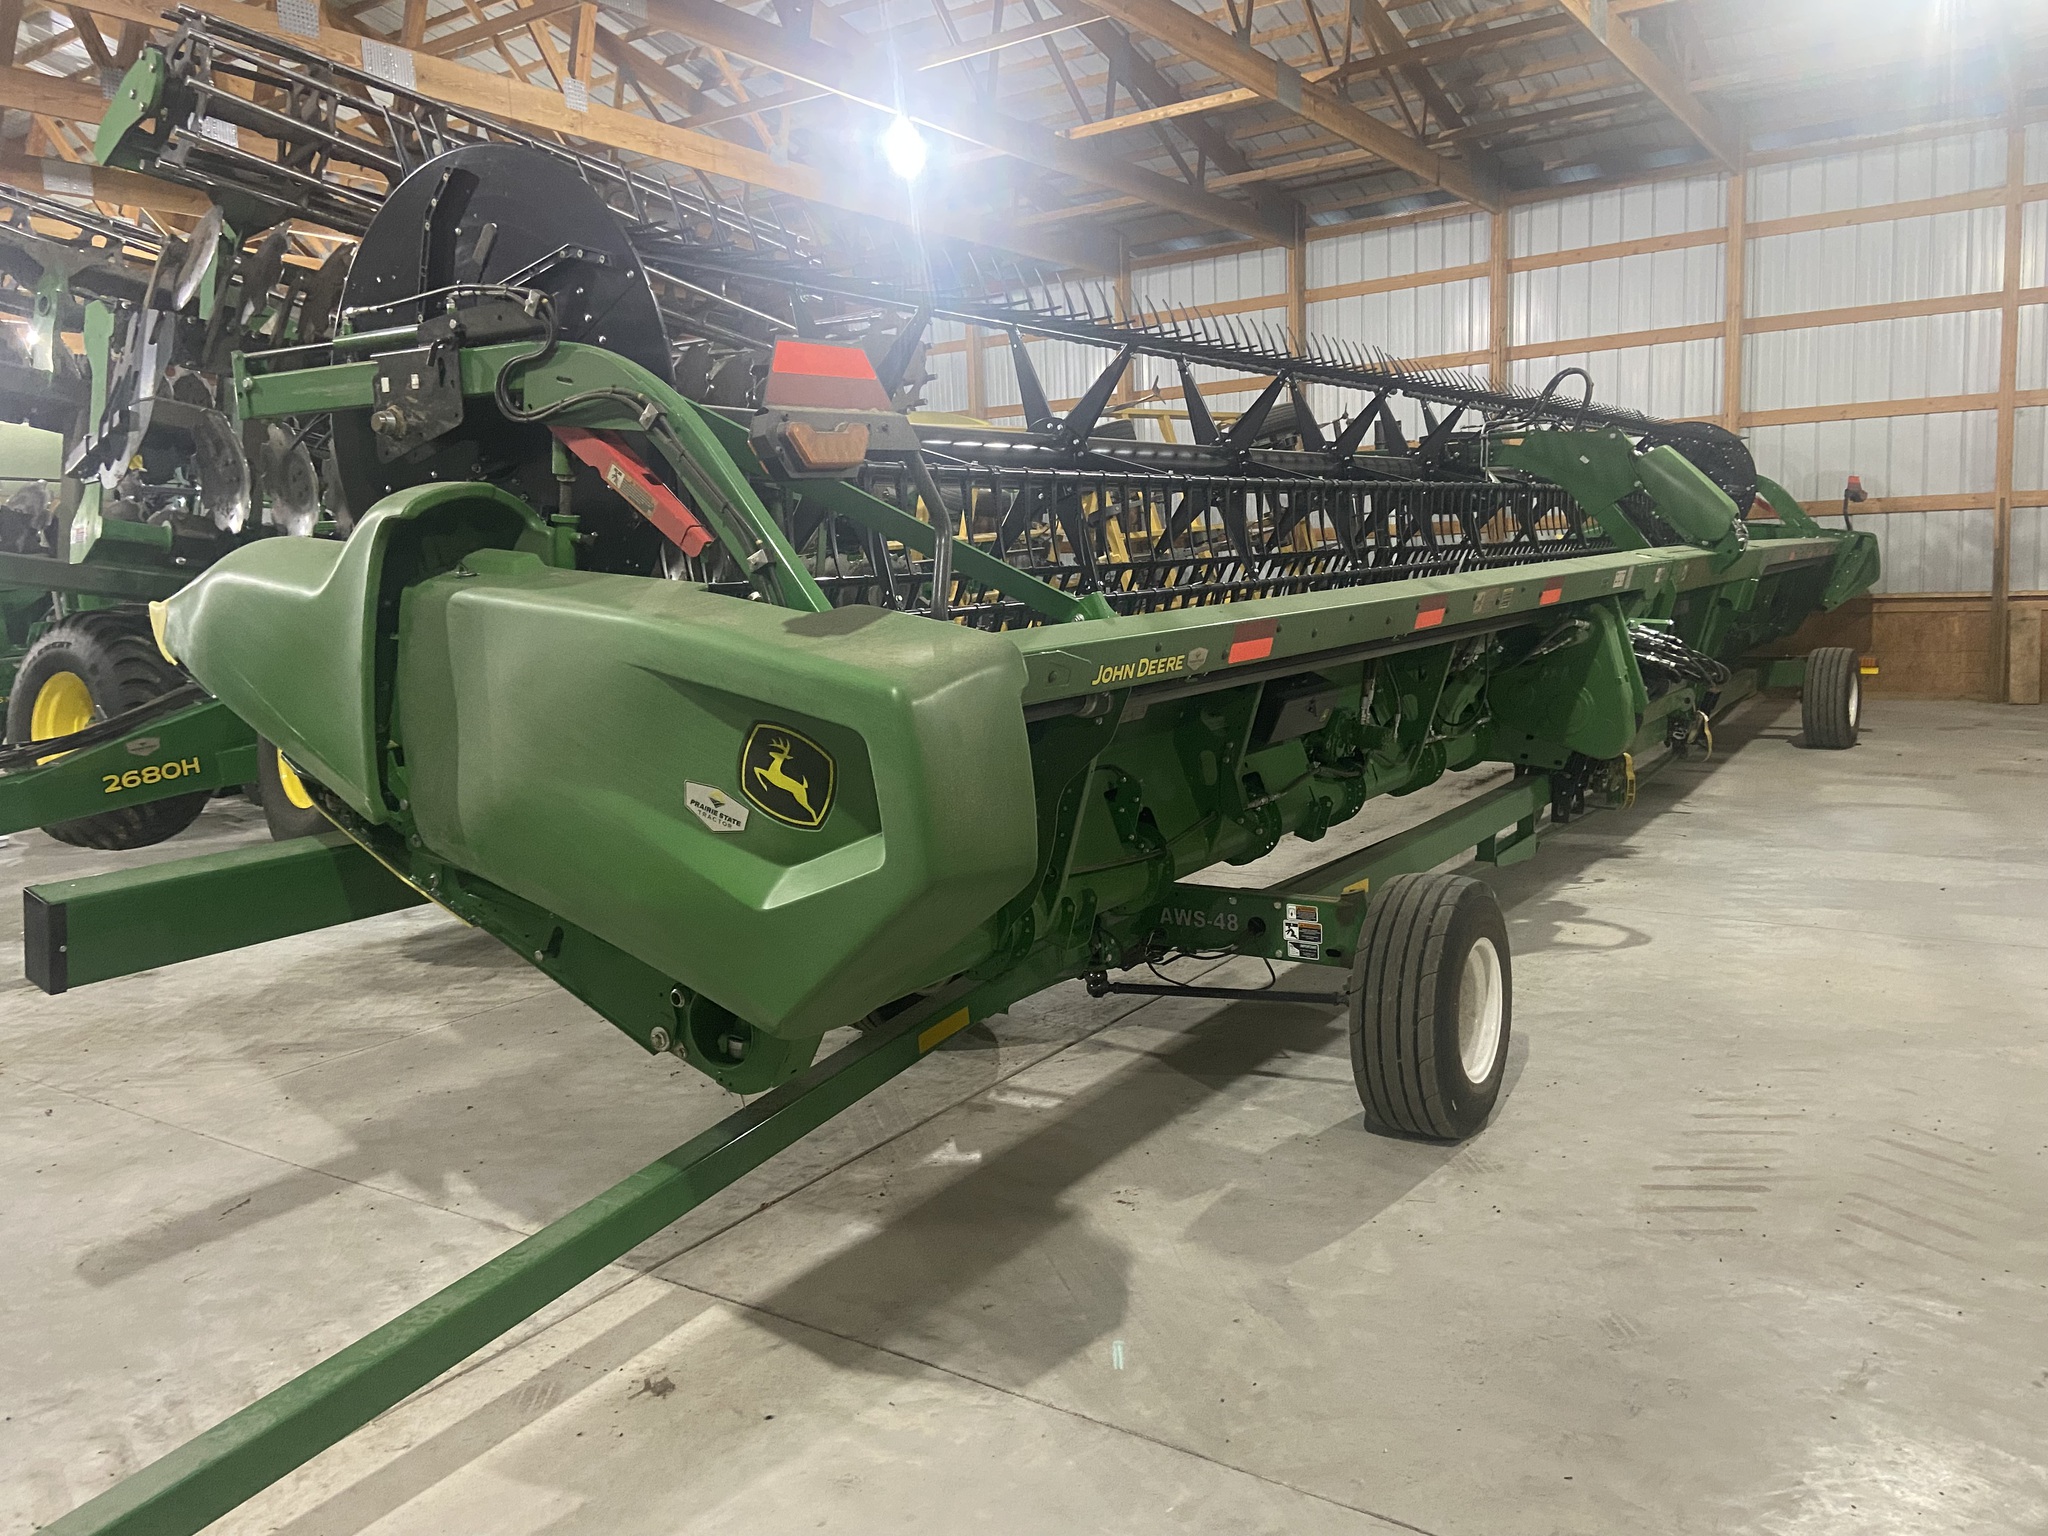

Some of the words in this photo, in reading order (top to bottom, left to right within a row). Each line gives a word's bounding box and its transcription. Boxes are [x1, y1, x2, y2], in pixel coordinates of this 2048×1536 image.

[1091, 664, 1136, 686] JOHN
[1137, 654, 1186, 678] DEERE
[102, 757, 201, 794] 2680H
[689, 798, 719, 817] PRAIRIE
[719, 812, 742, 827] STATE
[697, 809, 733, 829] TRACTOR
[1160, 907, 1239, 932] AWS-48
